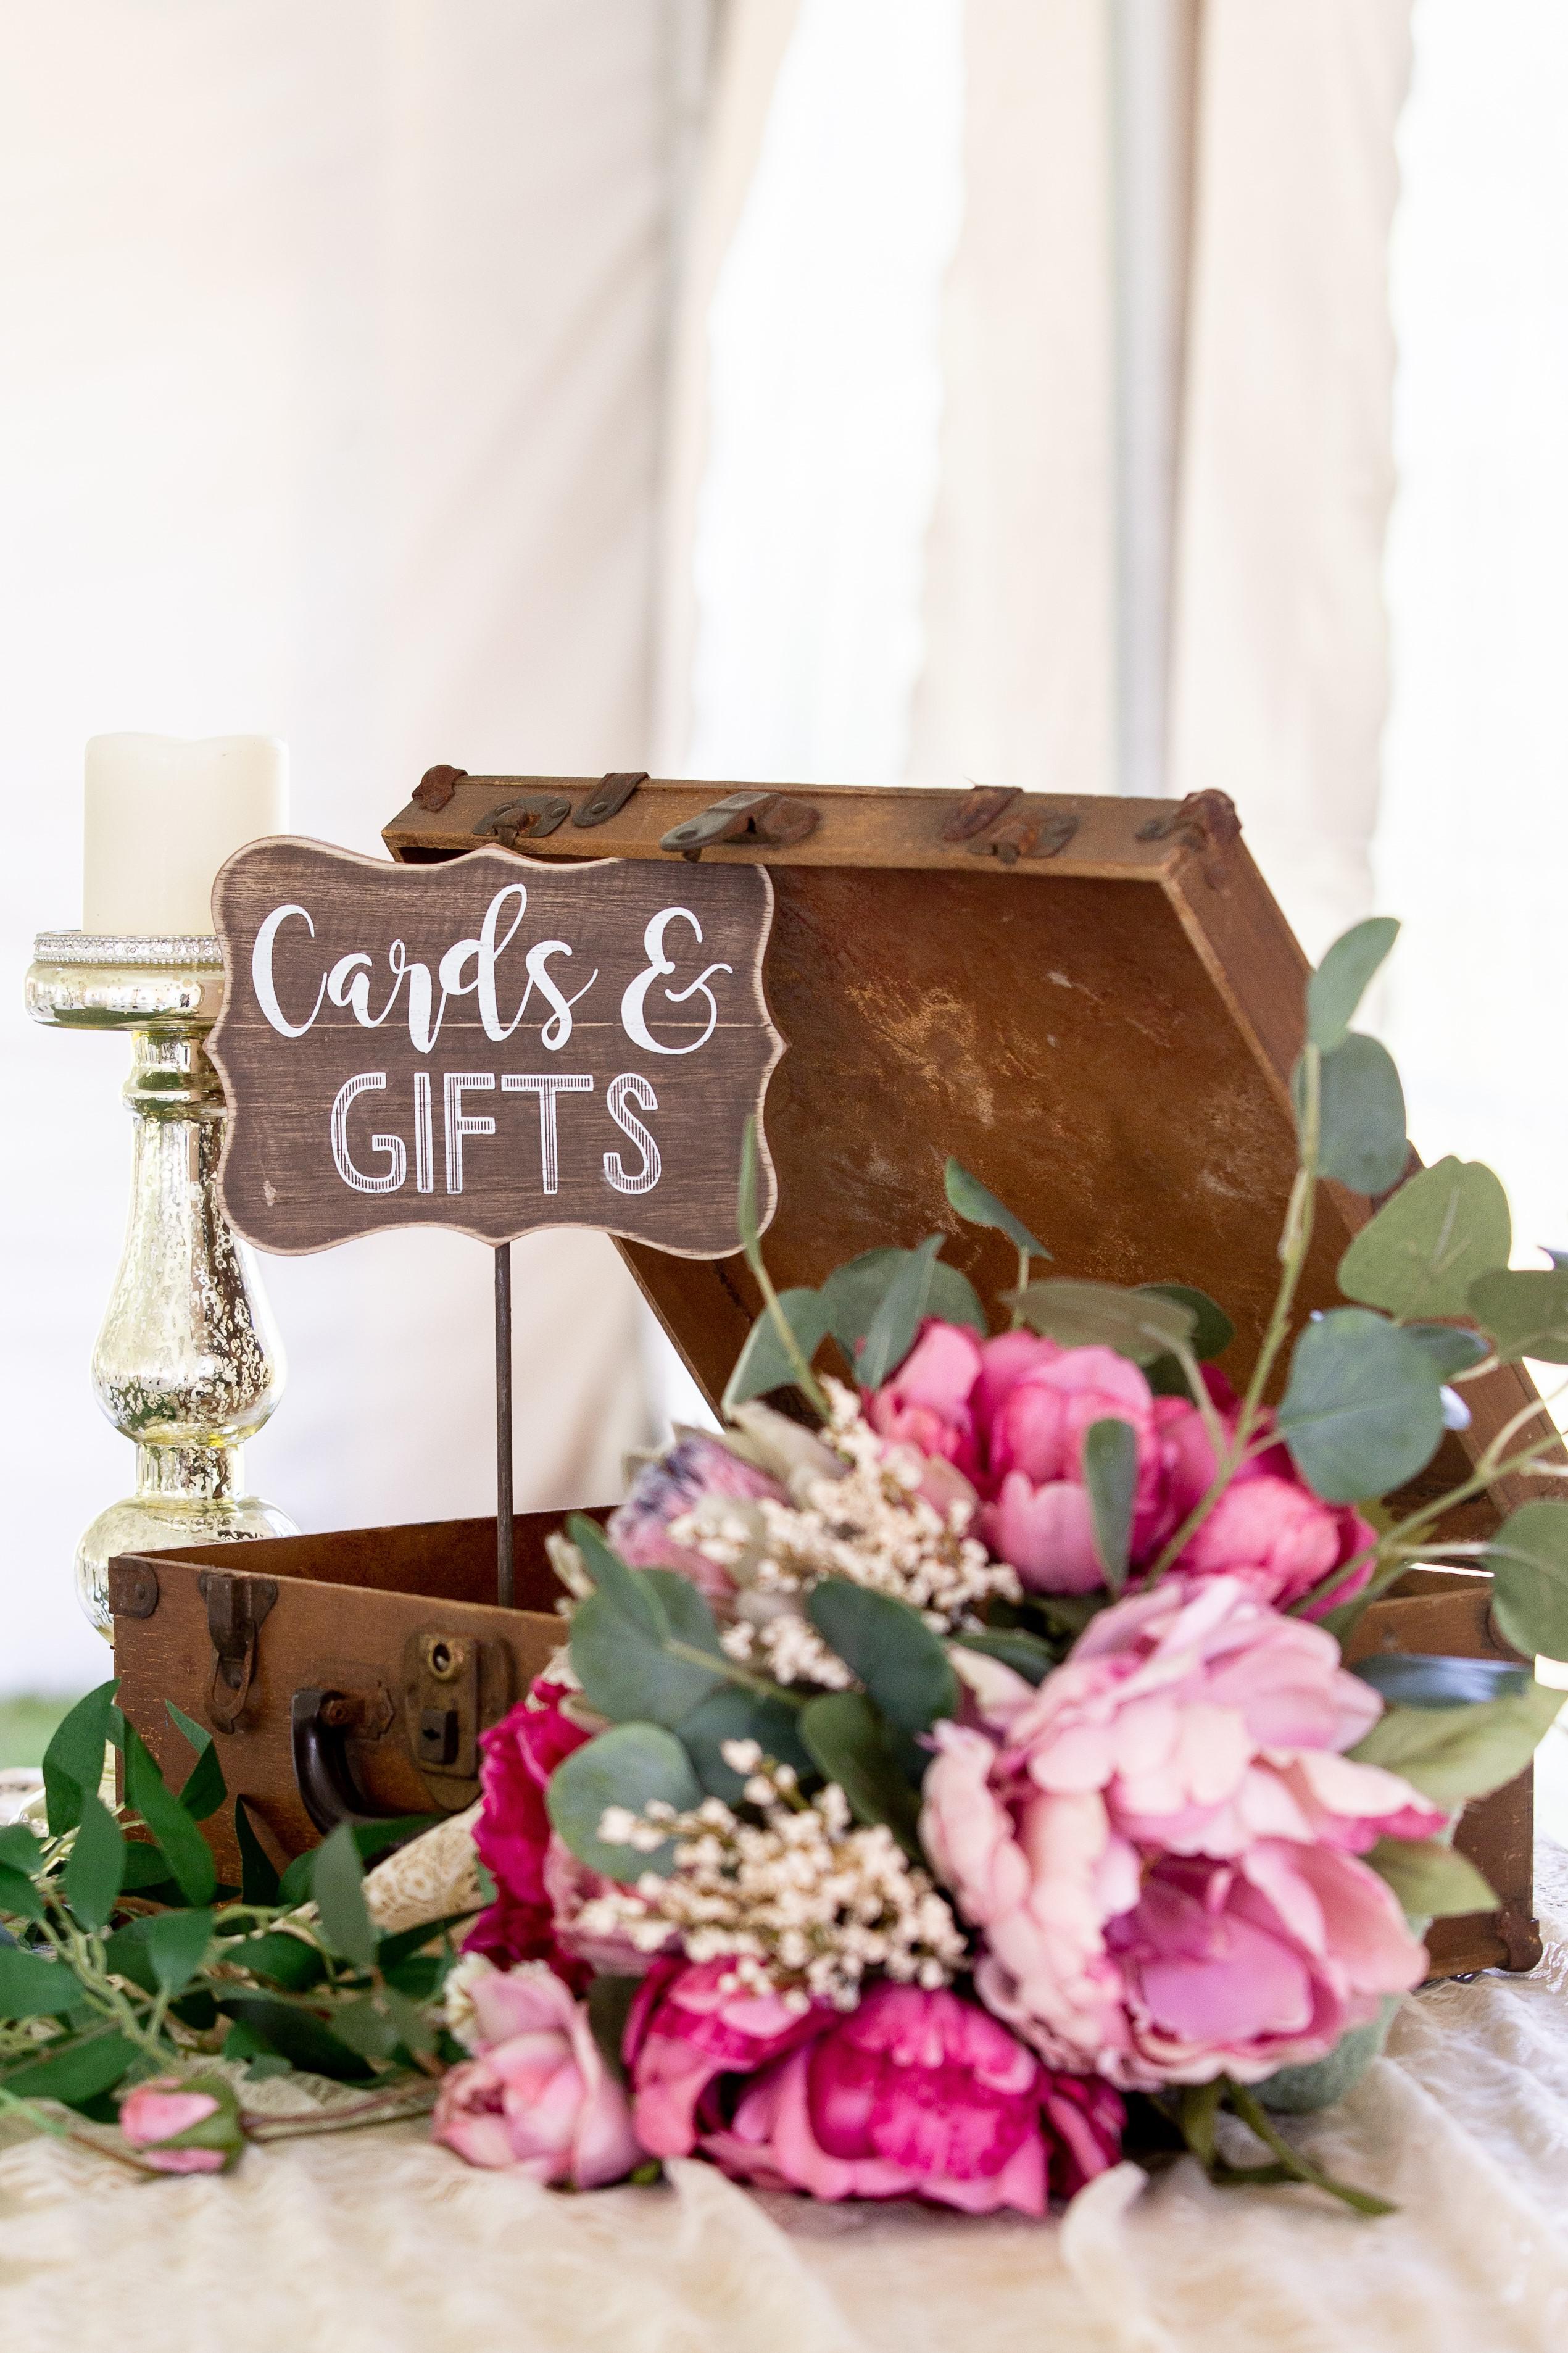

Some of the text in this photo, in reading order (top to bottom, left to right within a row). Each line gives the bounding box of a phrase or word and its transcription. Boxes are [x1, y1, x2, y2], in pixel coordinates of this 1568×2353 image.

[251, 883, 733, 1055] Cards &
[330, 1072, 662, 1195] GIFTS
